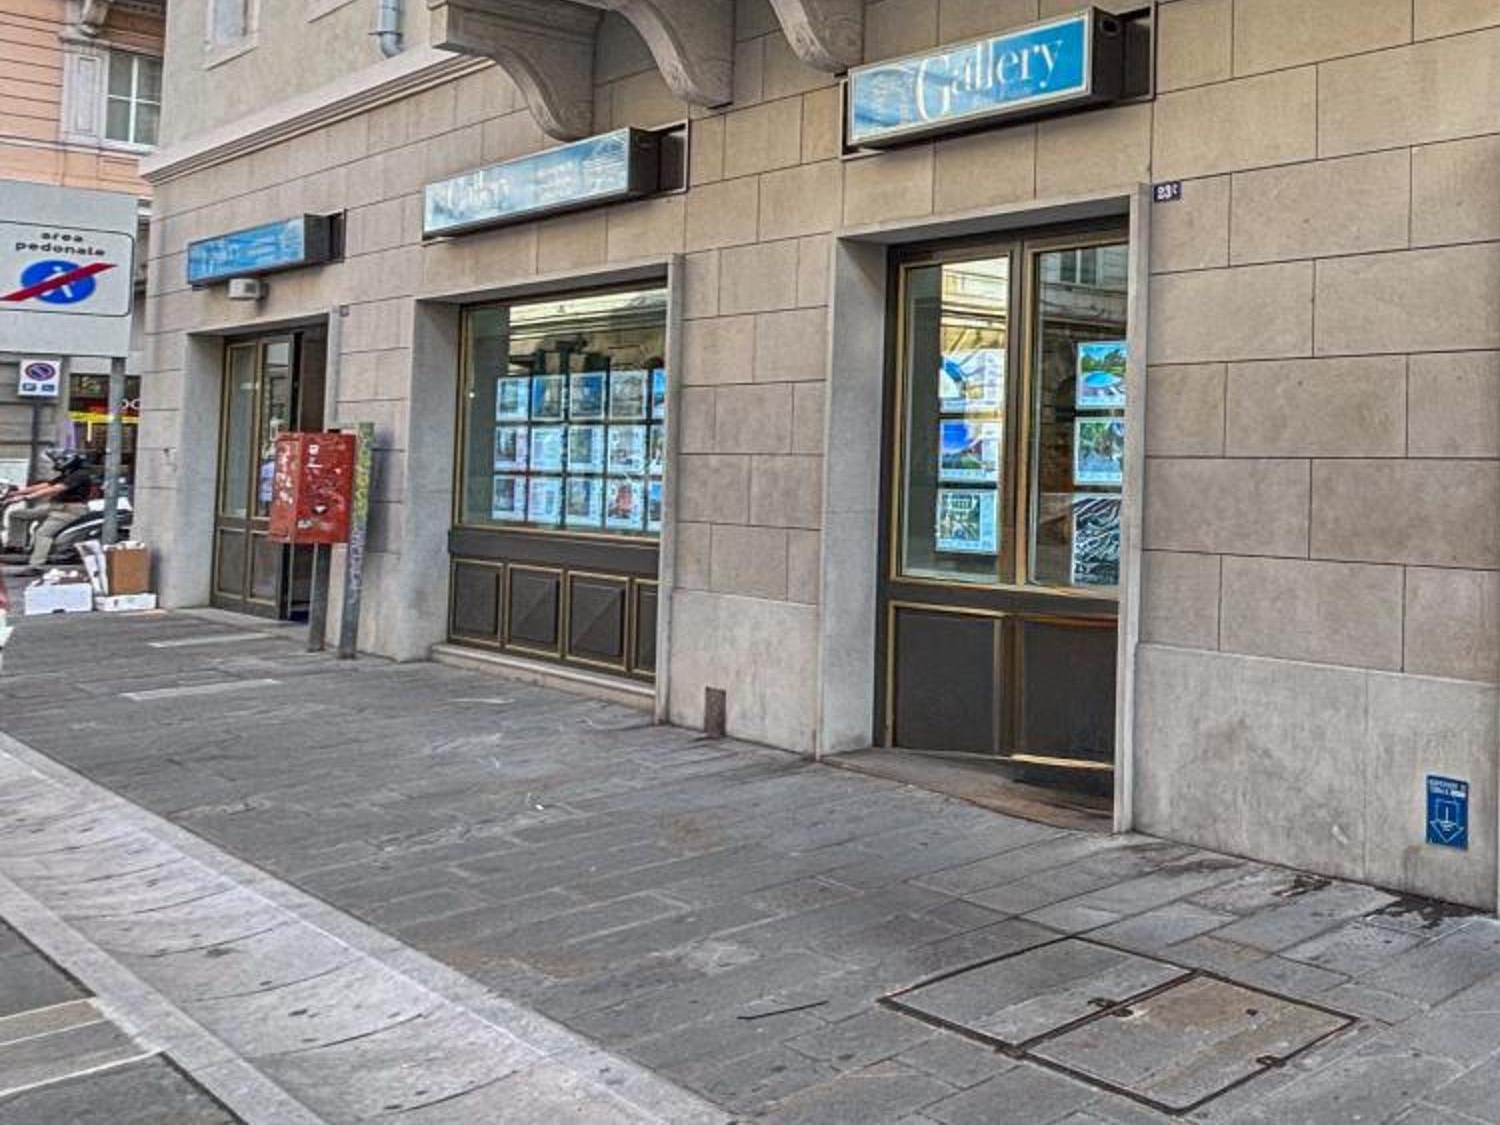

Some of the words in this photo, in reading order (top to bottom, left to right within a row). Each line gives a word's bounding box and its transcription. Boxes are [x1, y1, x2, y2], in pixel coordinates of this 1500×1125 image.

[916, 38, 1063, 121] Gallery
[41, 232, 83, 242] area
[15, 242, 105, 256] pedonale
